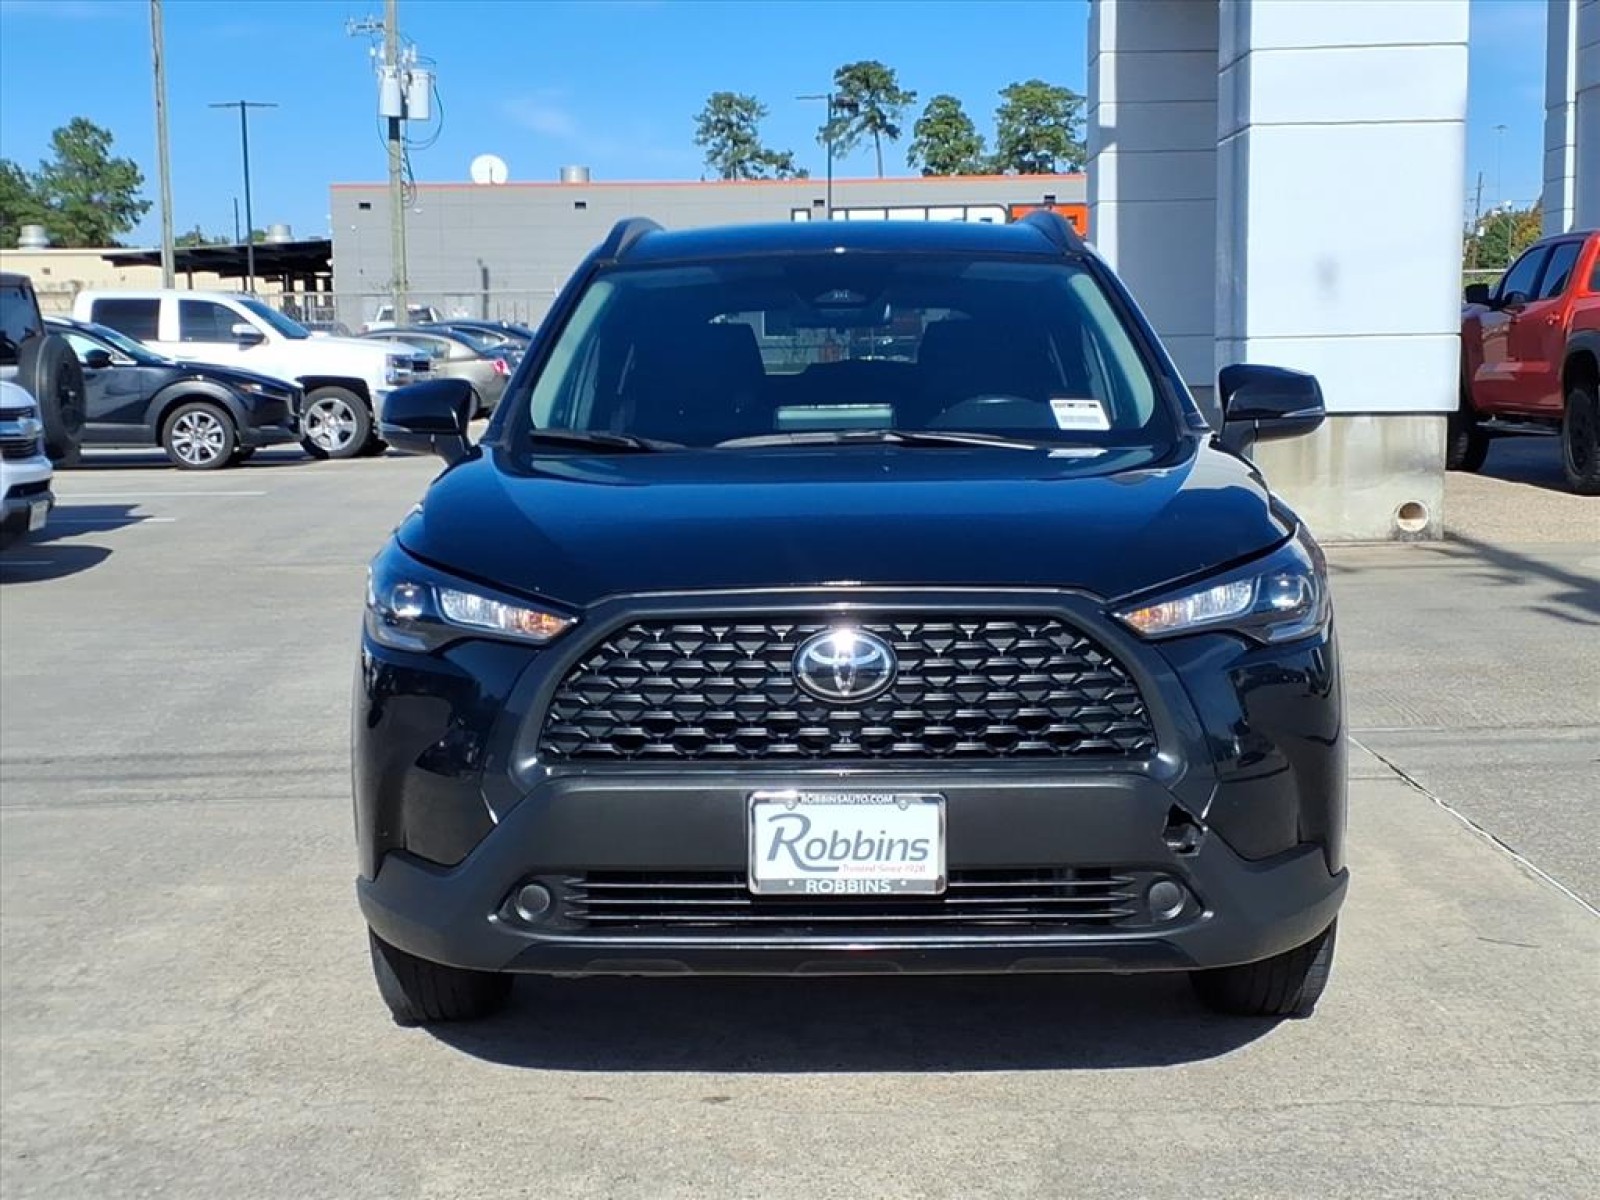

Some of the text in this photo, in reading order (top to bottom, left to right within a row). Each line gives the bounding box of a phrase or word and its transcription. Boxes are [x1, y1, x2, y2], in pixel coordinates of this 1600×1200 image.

[801, 793, 892, 804] ROBBINSAUTO.COM
[767, 813, 930, 872] Robbins
[805, 879, 891, 893] ROBBINS
